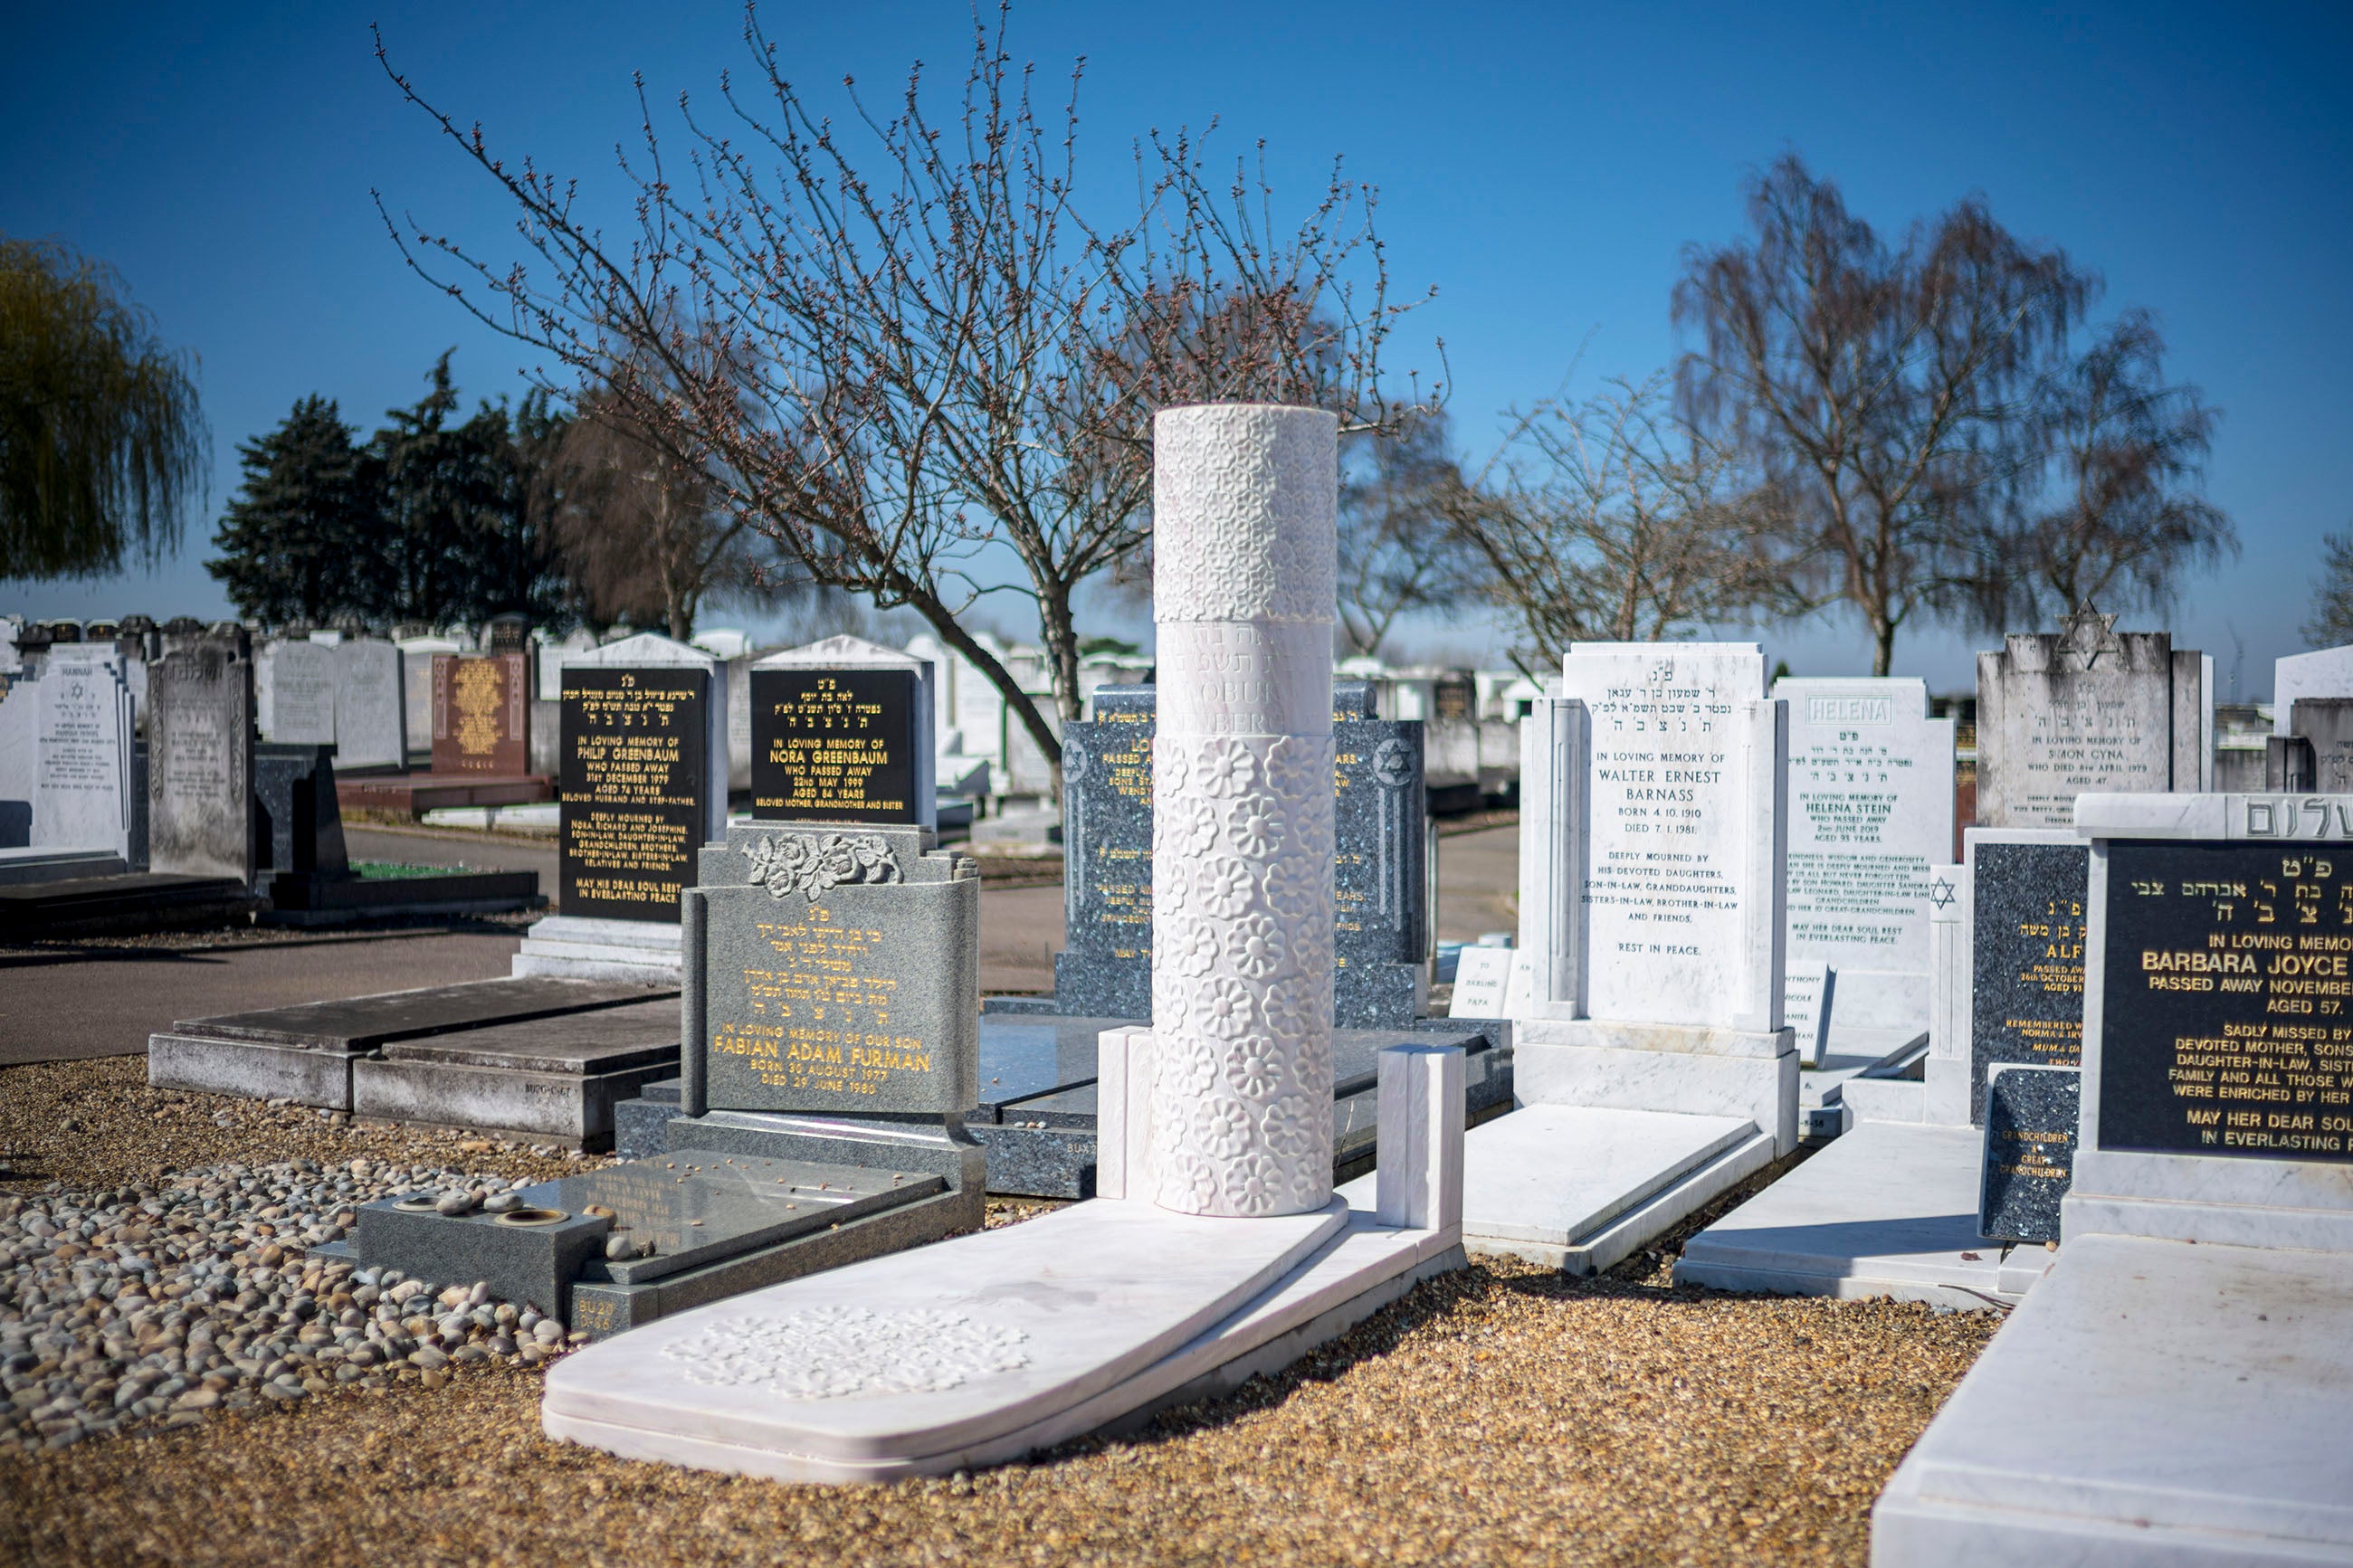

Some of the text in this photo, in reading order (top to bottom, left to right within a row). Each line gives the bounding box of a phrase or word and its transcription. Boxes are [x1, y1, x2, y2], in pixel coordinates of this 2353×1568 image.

[1814, 701, 1887, 720] HELENA
[577, 736, 679, 747] IN LOVING MEMORY OF
[773, 739, 884, 749] IN LOVING MEMORY OF
[577, 747, 679, 762] PHILIP GREENBAUM
[770, 749, 888, 764] NORA GREENBAUM
[1597, 753, 1725, 763] IN LOVING MEMORY OF
[586, 762, 669, 774] WHO PASSED AWAY
[785, 765, 872, 776] WHO PASSED AWAY
[819, 778, 837, 787] MAY
[843, 778, 863, 787] 1999
[1600, 770, 1721, 783] WALTER ERNEST
[595, 784, 661, 795] AGED 74 YEARS
[793, 789, 816, 798] AGED
[837, 789, 864, 799] YEARS
[1626, 789, 1693, 802] BARNASS
[757, 797, 783, 807] BELOVED
[814, 799, 864, 809] GRANDMOTHER
[866, 800, 881, 810] AND
[882, 801, 903, 810] SISTER
[1813, 794, 1845, 802] LOVING
[1619, 808, 1647, 816] BORN
[1681, 809, 1701, 818] 1910
[1806, 803, 1891, 814] HELENA STEIN
[1625, 824, 1649, 832] DIED
[1609, 851, 1641, 860] DEEPLY
[1646, 853, 1691, 861] MOURNED
[1617, 868, 1661, 876] DEVOTED
[1657, 899, 1738, 909] BROTHER-IN-LAW
[1619, 944, 1643, 952] REST
[1650, 945, 1661, 954] IN
[2209, 935, 2224, 947] IN
[2233, 935, 2292, 950] LOVING
[2142, 951, 2348, 976] BARBARA JOYCE
[2149, 976, 2353, 995] PASSED AWAY NOVEMBE
[2266, 999, 2343, 1015] AGED 57.
[722, 1022, 921, 1050] IN LOVING MEMORY OF OUR SON
[2224, 1023, 2351, 1041] SADLY MISSED BY
[714, 1035, 930, 1071] FABIAN ADAM FURMAN
[2176, 1038, 2240, 1052] DEVOTED
[2245, 1041, 2308, 1056] MOTHER,
[2177, 1054, 2313, 1071] DAUGHTER-IN-LAW,
[750, 1060, 888, 1081] BORN 30 AUGUST 1977
[762, 1073, 876, 1095] DIED 29 JUNE 1980
[2168, 1069, 2215, 1082] FAMILY
[2220, 1071, 2250, 1084] AND
[2255, 1072, 2281, 1085] ALL
[2287, 1074, 2335, 1088] THOSE
[2173, 1085, 2349, 1104] WERE ENRICHED BY HER
[2186, 1110, 2221, 1126] MAY
[2227, 1113, 2262, 1127] HER
[2268, 1115, 2313, 1129] DEAR
[2202, 1131, 2340, 1151] IN EVERLASTING
[2031, 1145, 2037, 1153] &
[2021, 1155, 2045, 1165] GREAT
